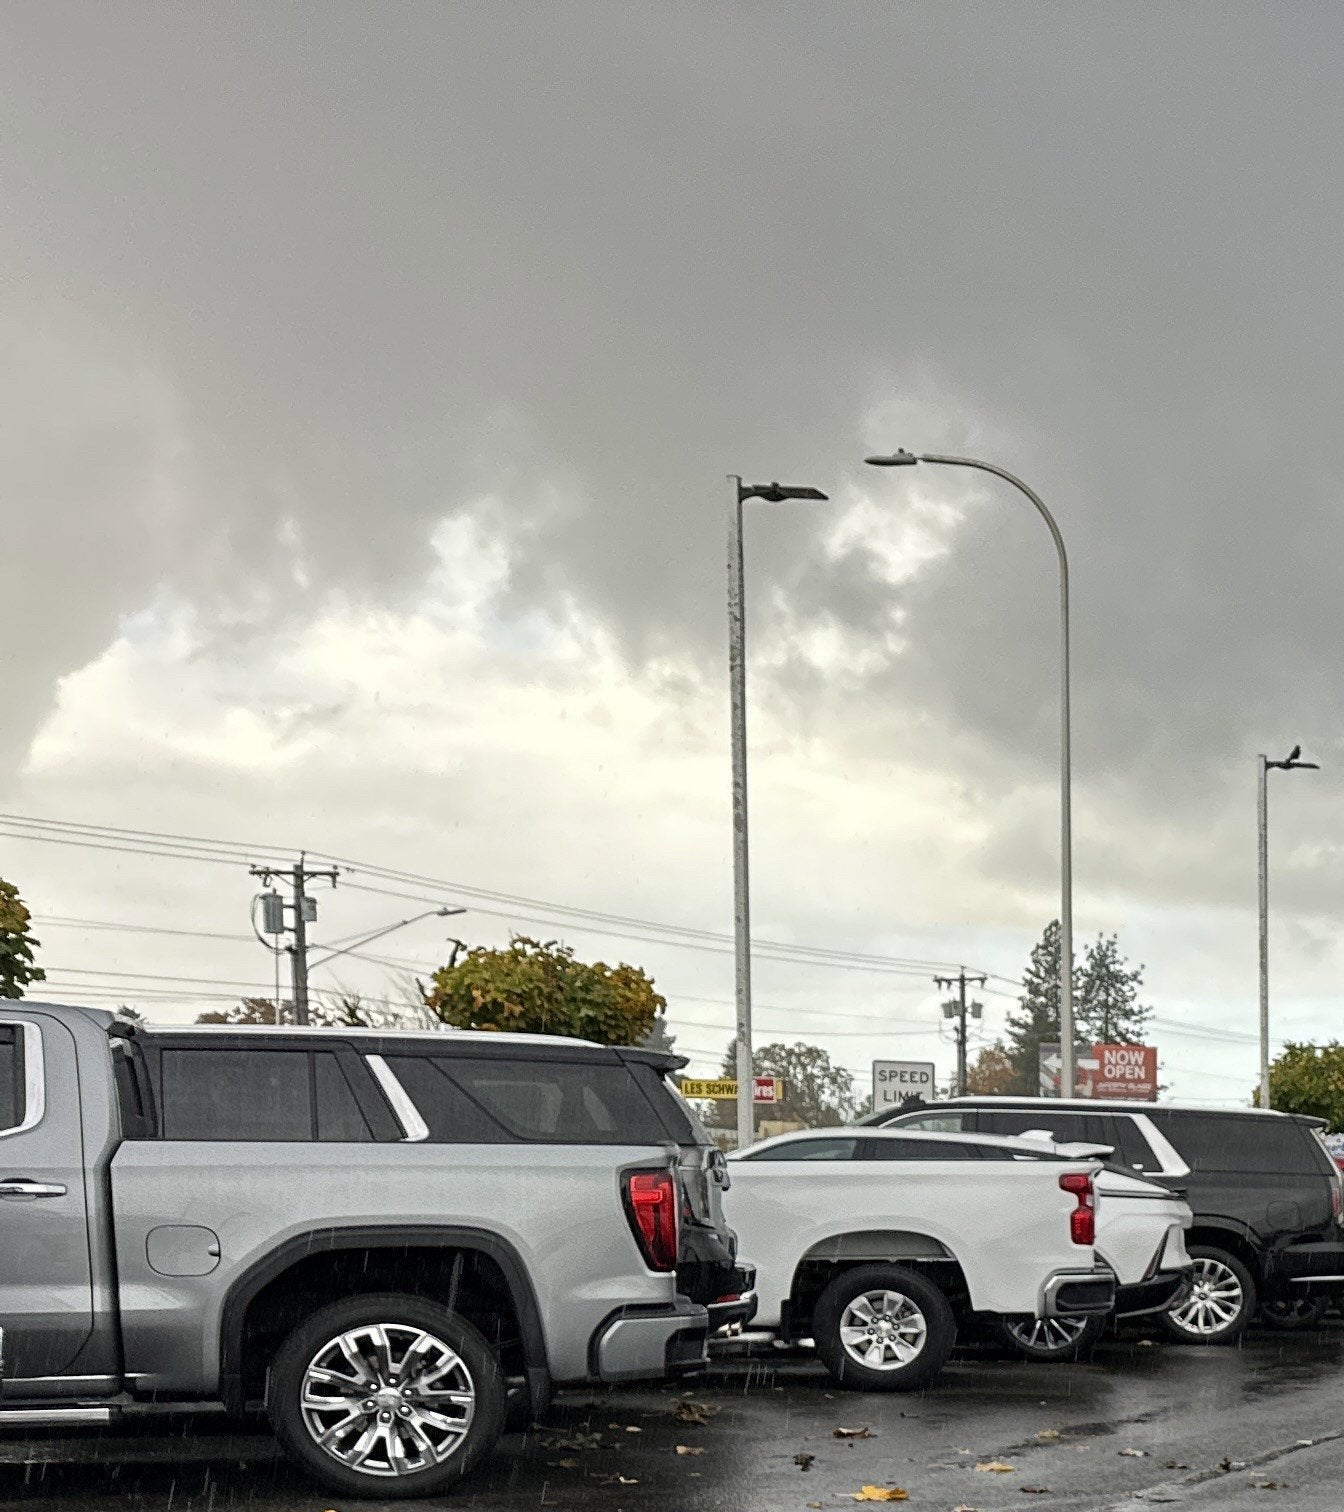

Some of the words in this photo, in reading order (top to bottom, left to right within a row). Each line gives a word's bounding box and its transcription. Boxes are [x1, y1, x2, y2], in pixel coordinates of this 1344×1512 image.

[1103, 1049, 1146, 1065] NOW
[878, 1069, 930, 1084] SPEED
[1103, 1065, 1146, 1080] OPEN
[684, 1082, 703, 1096] LES
[705, 1082, 738, 1096] SCHW
